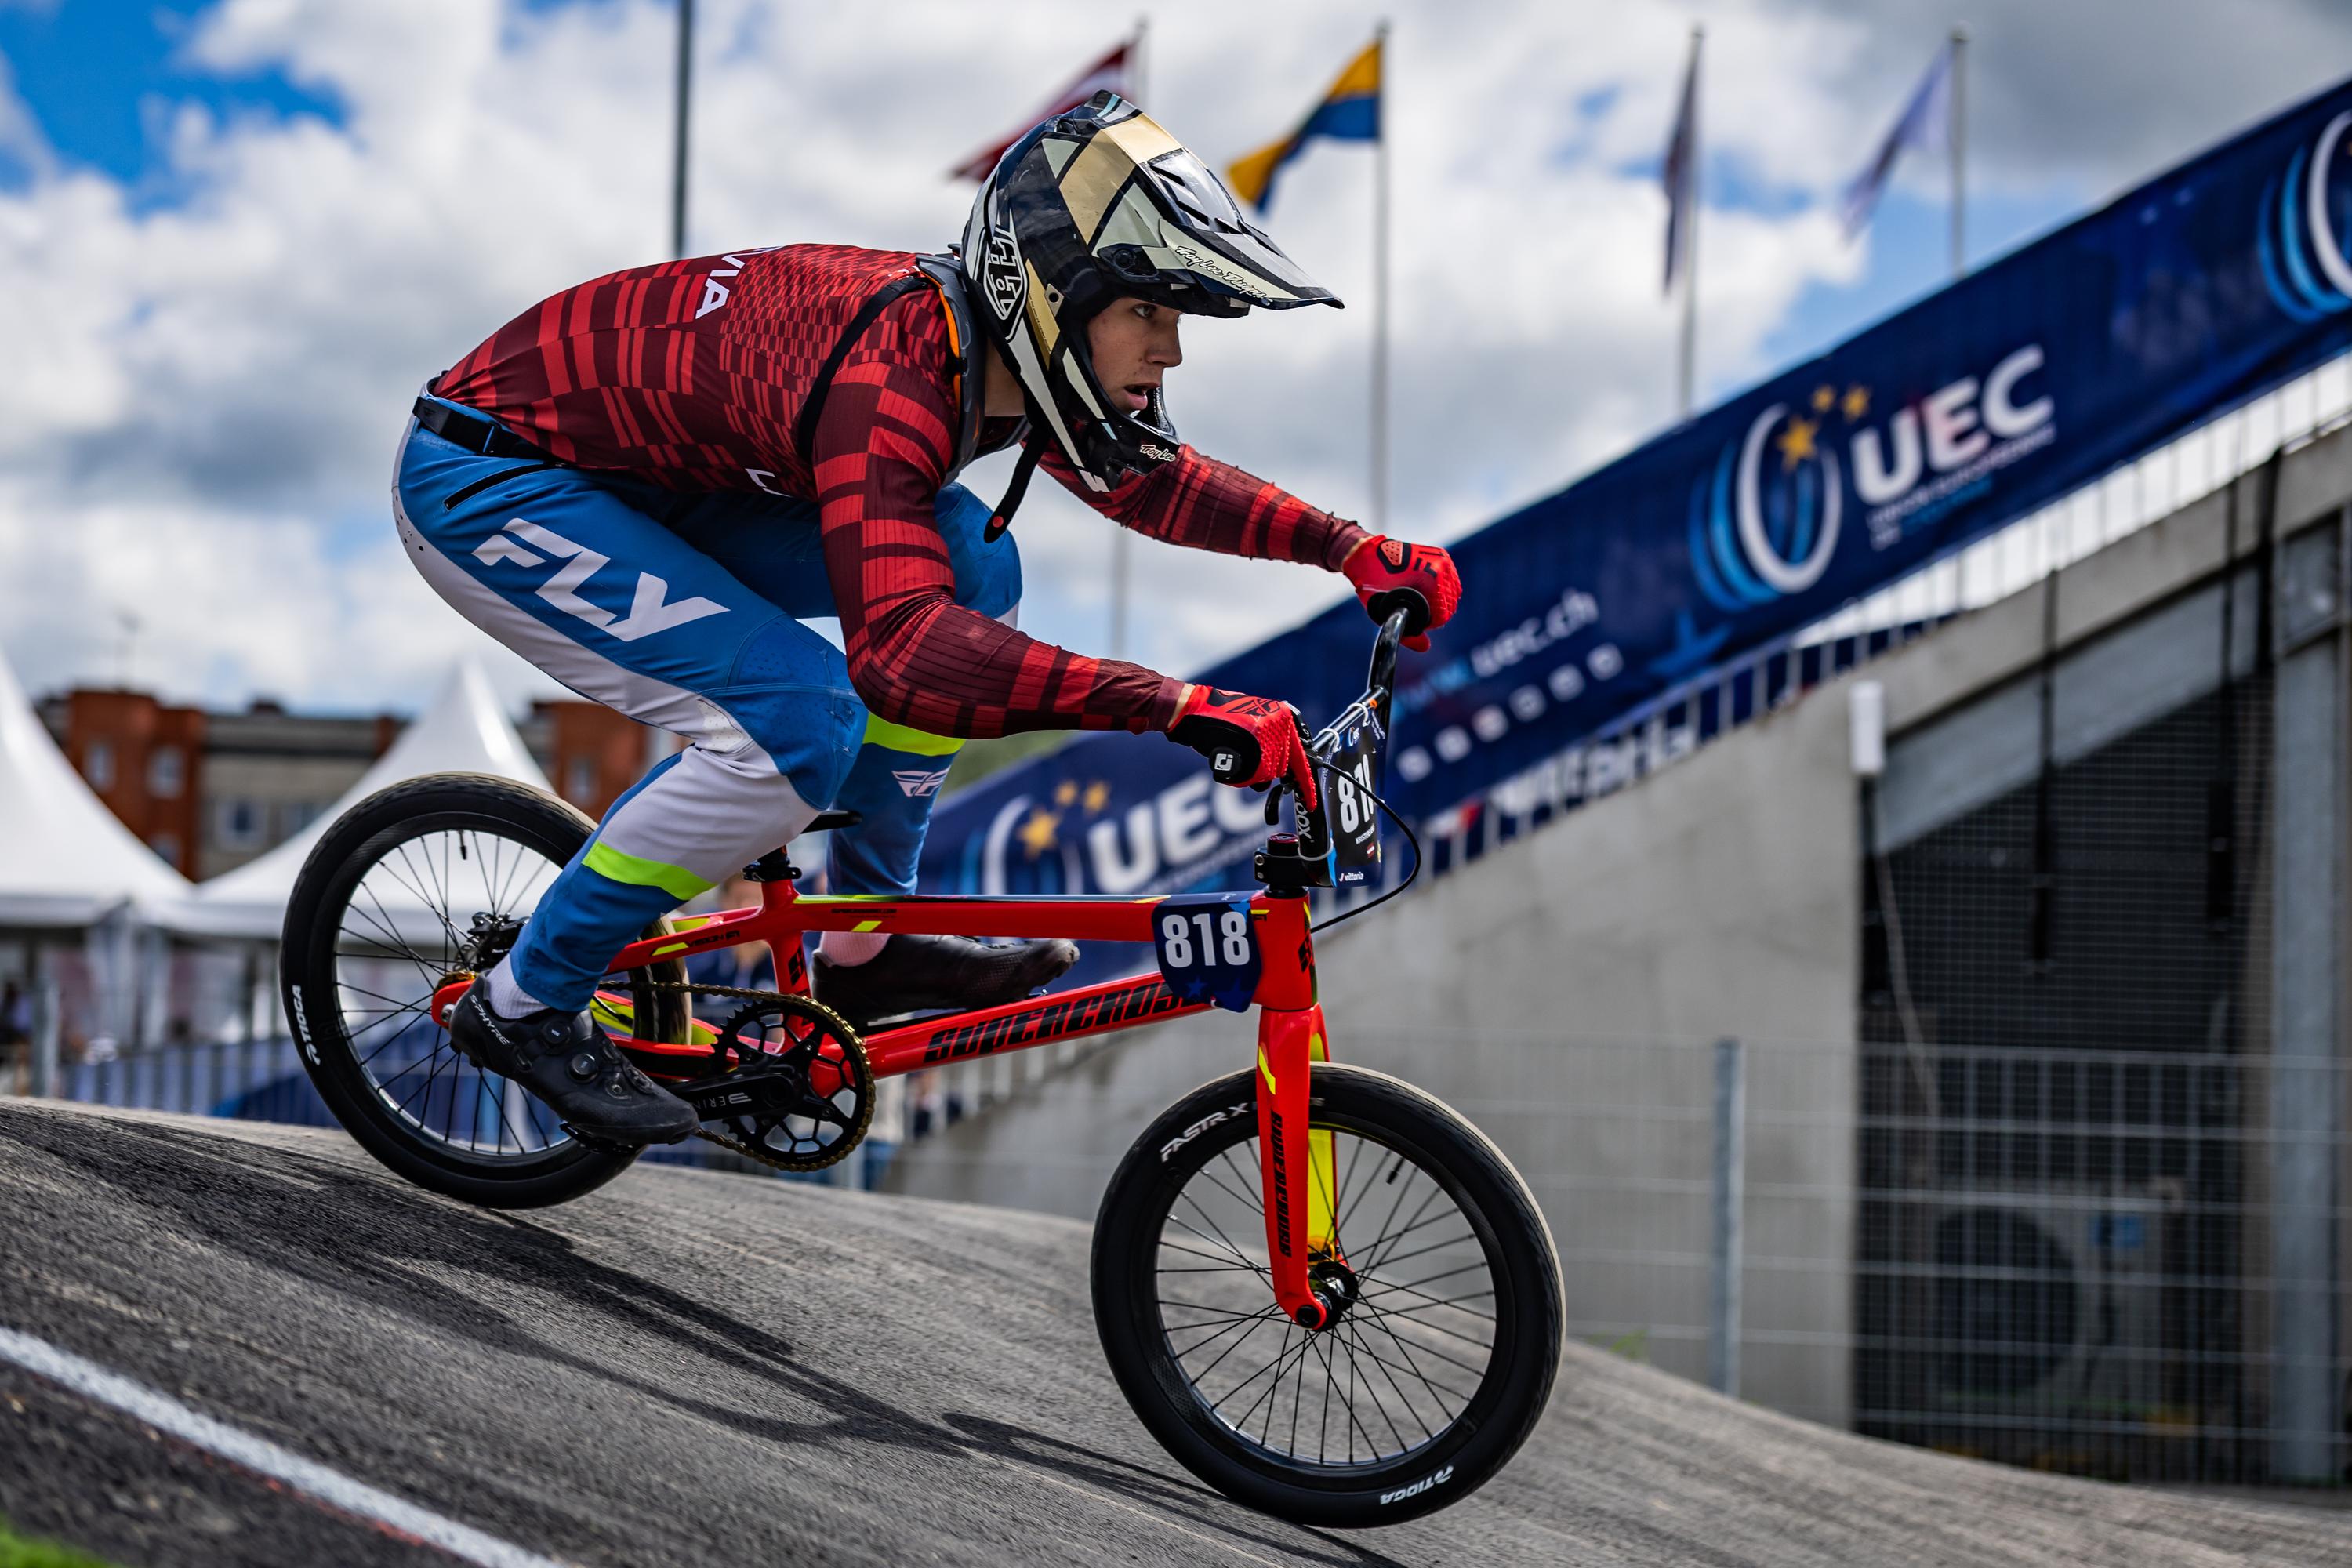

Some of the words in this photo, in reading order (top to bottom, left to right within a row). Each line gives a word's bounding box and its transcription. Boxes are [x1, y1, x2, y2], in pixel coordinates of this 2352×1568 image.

[1176, 246, 1204, 267] Troy
[1200, 260, 1223, 276] Lee
[1223, 272, 1272, 298] Designs
[1849, 343, 2055, 503] UEC
[1140, 444, 1160, 459] Troy
[1158, 448, 1176, 462] Lee
[471, 518, 731, 642] FLY
[1162, 911, 1250, 967] 818
[292, 985, 312, 1044] TIOGA
[1380, 1475, 1436, 1505] TIOGA
